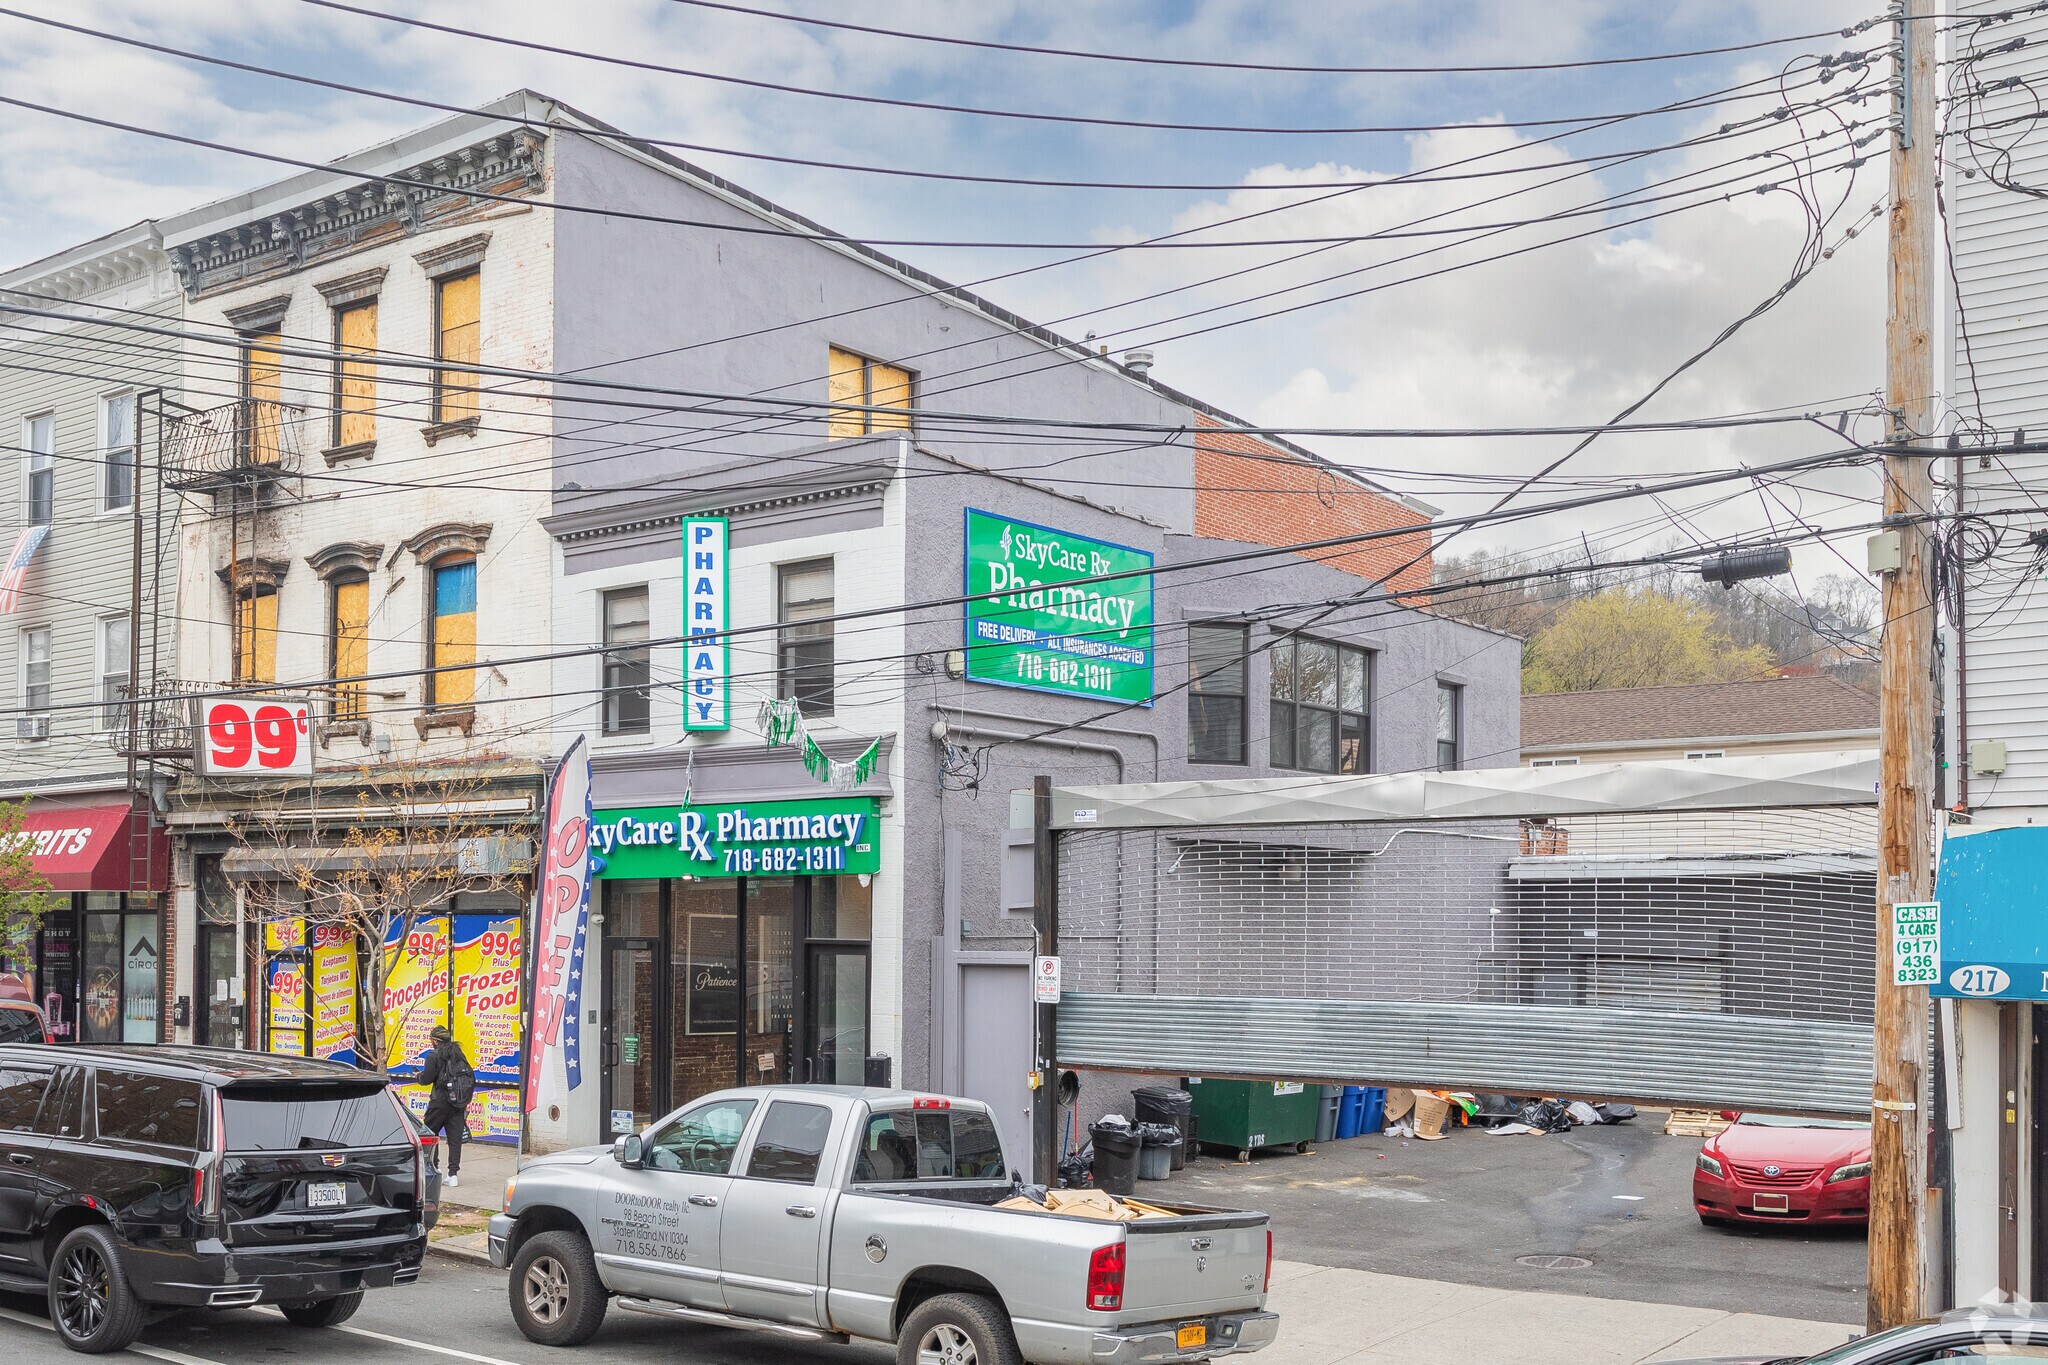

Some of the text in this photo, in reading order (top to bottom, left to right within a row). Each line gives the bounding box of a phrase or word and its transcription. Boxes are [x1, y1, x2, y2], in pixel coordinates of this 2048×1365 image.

[1015, 533, 1112, 577] SkyCare Rx
[988, 561, 1136, 639] Pharmacy
[691, 527, 717, 720] PHARMACY
[978, 622, 999, 640] FREE
[1000, 625, 1037, 645] DELIVERY
[1047, 634, 1062, 650] ALL
[1016, 651, 1112, 692] 718-682-1311
[208, 703, 308, 769] 99¢
[587, 809, 864, 861] kyCare Rx Pharmacy
[856, 843, 870, 852] INC
[723, 845, 843, 872] 718-682-1311
[315, 926, 353, 944] 99¢
[544, 816, 587, 1047] OPEN
[1898, 924, 1937, 936] 4 CARS
[325, 940, 343, 949] Plus
[408, 932, 448, 960] 99¢
[481, 932, 521, 961] 99¢
[1896, 940, 1938, 955] (917)
[418, 957, 435, 967] Plus
[492, 957, 511, 968] Plus
[1902, 955, 1933, 968] 436
[695, 971, 738, 991] Patience
[1897, 968, 1938, 982] 8323
[1961, 969, 1998, 992] 217
[273, 972, 303, 998] 99¢
[383, 970, 448, 1012] Groceries
[465, 985, 518, 1015] Food
[274, 1013, 304, 1025] Every Day
[405, 1008, 426, 1016] Frozen
[478, 1013, 501, 1021] Frozen
[474, 1021, 512, 1030] We Accept:
[405, 1033, 421, 1041] Food
[479, 1030, 514, 1039] WIC Cards
[405, 1041, 433, 1050] EBT Card
[479, 1039, 520, 1048] Food Stamp
[479, 1047, 514, 1056] EBT Cards
[405, 1058, 424, 1066] Credit
[479, 1064, 500, 1073] Credit
[419, 1091, 431, 1099] Savin
[490, 1091, 501, 1101] Party
[490, 1103, 500, 1112] Toys
[510, 1116, 520, 1124] Item
[1248, 1133, 1265, 1148] 2 YDS
[662, 1201, 680, 1216] realty
[623, 1208, 680, 1228] 98 Beach Street
[612, 1225, 636, 1239] Staten
[616, 1239, 687, 1261] 718.556.7866
